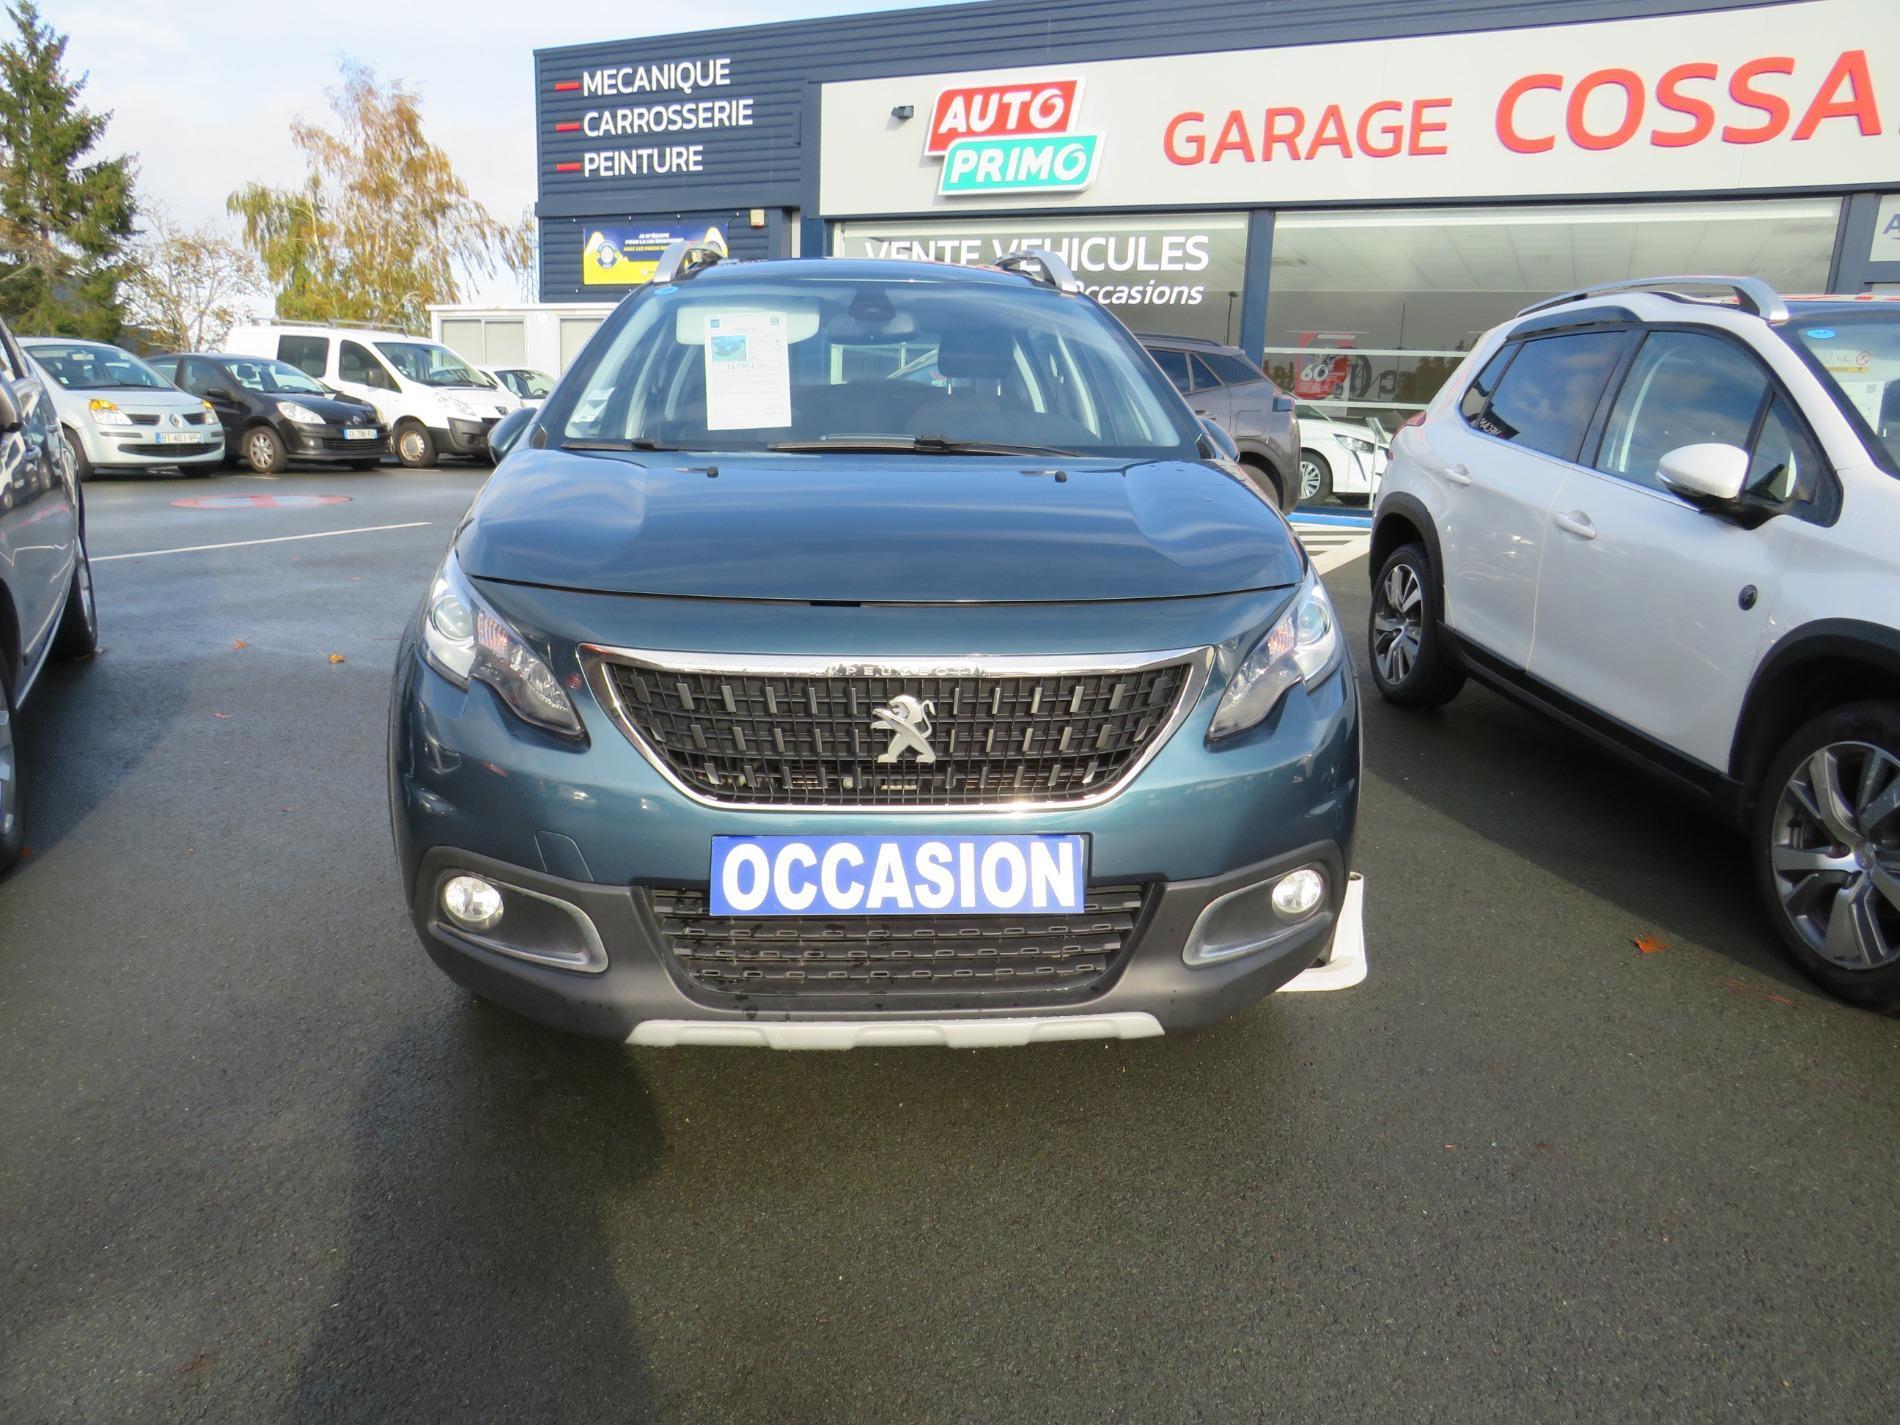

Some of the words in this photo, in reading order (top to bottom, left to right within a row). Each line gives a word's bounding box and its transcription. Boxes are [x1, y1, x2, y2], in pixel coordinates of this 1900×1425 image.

[582, 57, 731, 97] MECANIQUE
[583, 99, 754, 137] CARROSSERIE
[937, 88, 1065, 134] AUTO
[1163, 97, 1453, 166] GARAGE
[1494, 49, 1884, 154] COSSA
[583, 145, 704, 178] PEINTURE
[949, 143, 1087, 183] PRIMO
[864, 239, 981, 266] VENTE
[992, 235, 1209, 272] VEHICULES
[1074, 279, 1204, 305] ccasions
[722, 842, 1075, 911] OCCASION
